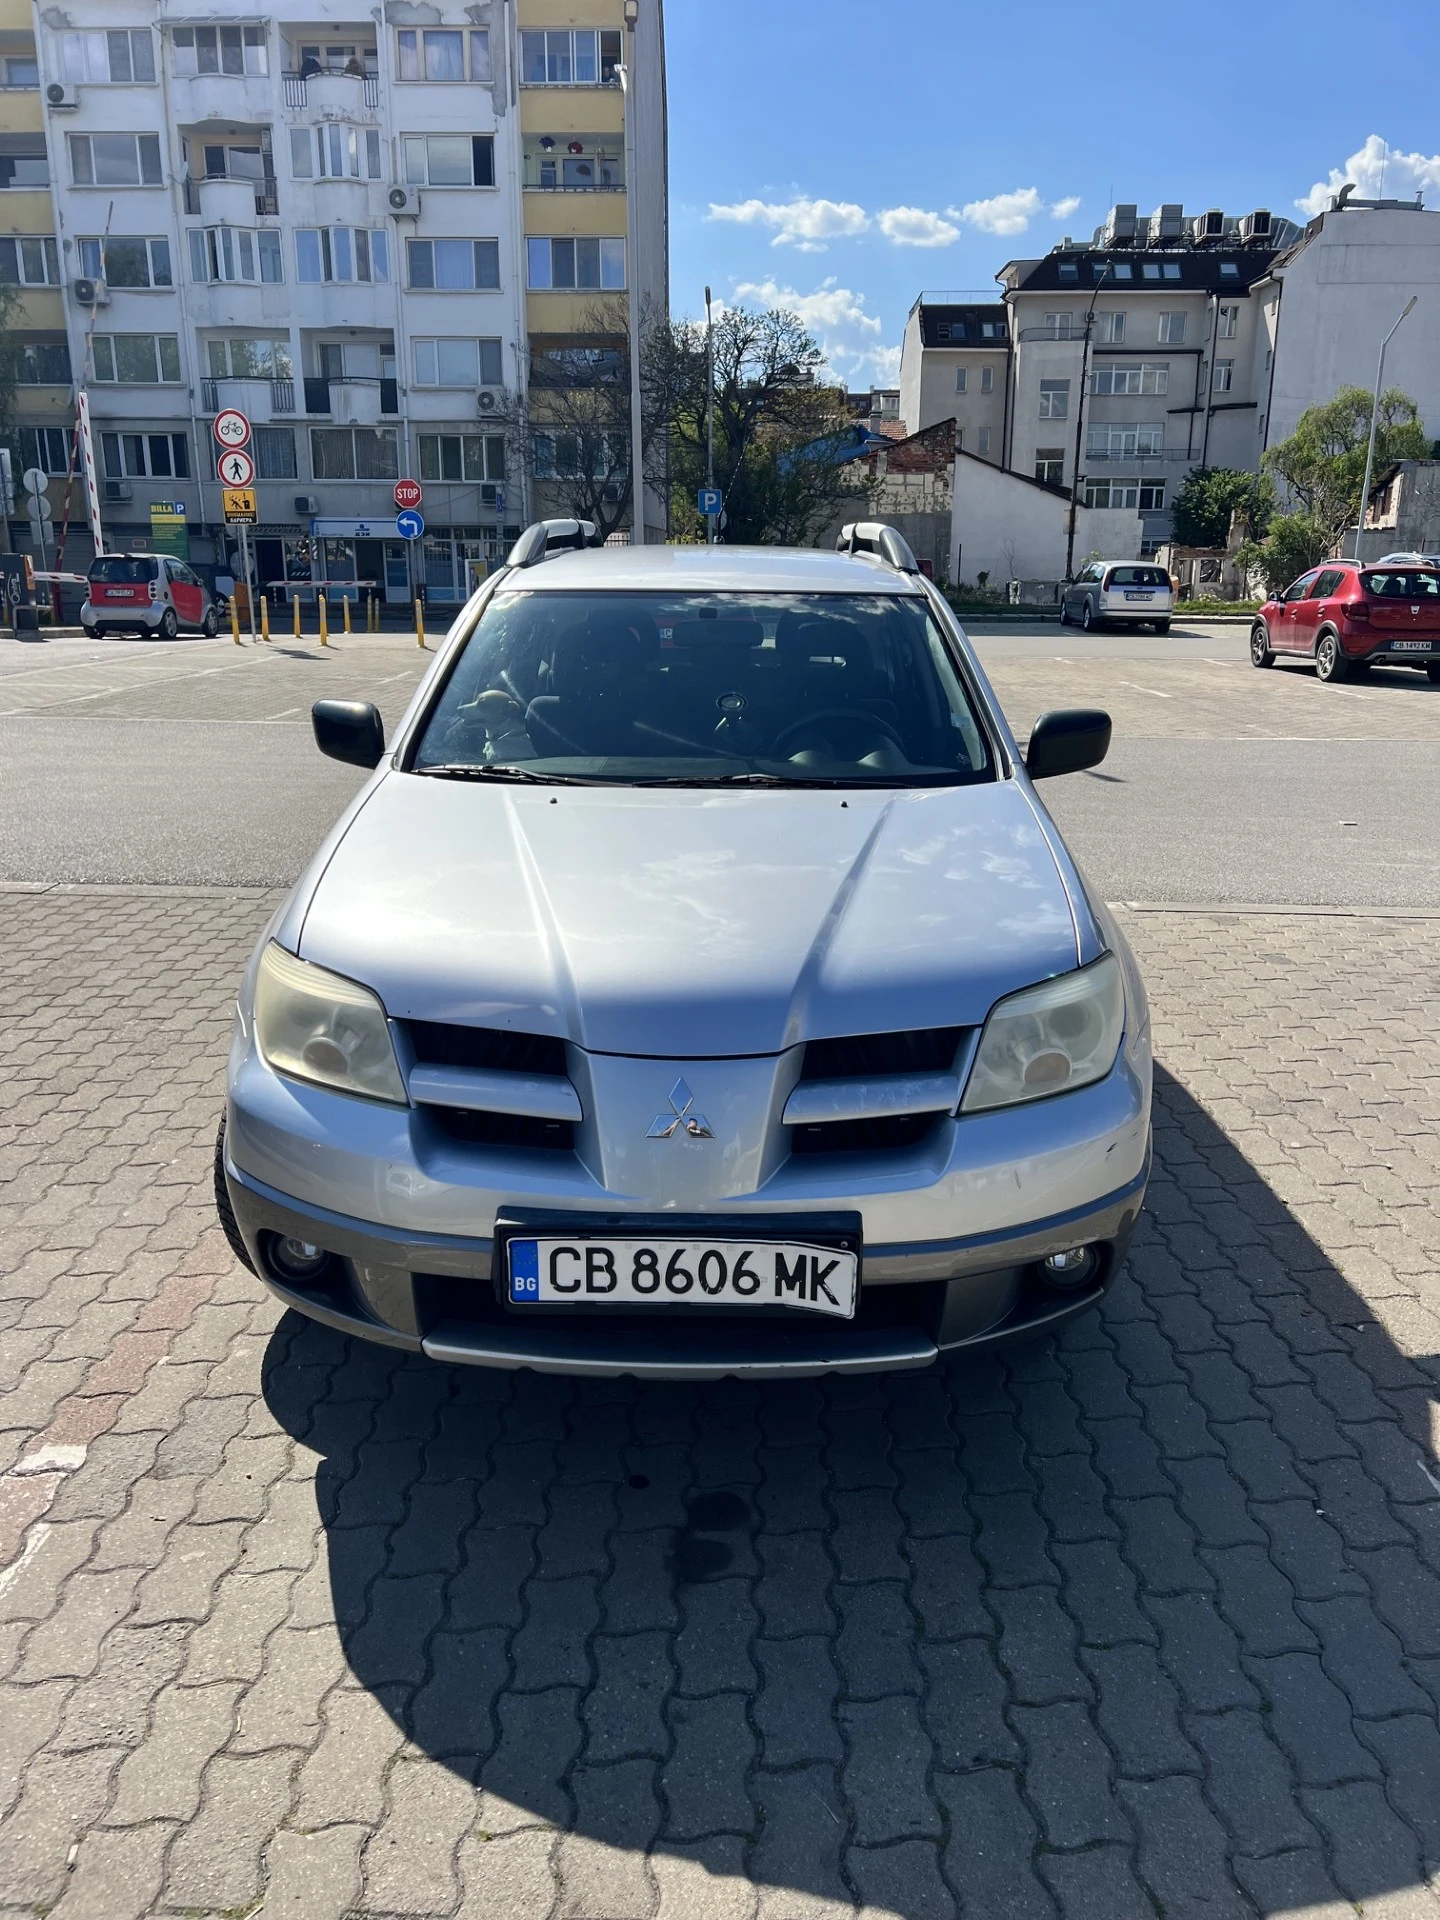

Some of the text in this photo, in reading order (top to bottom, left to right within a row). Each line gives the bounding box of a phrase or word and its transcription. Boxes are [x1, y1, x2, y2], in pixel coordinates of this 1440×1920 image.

[397, 488, 418, 499] STOP
[151, 504, 173, 513] BILLA
[176, 504, 184, 513] P
[704, 493, 717, 511] P
[550, 1246, 841, 1307] CB 8606 MK
[514, 1276, 537, 1291] BG
